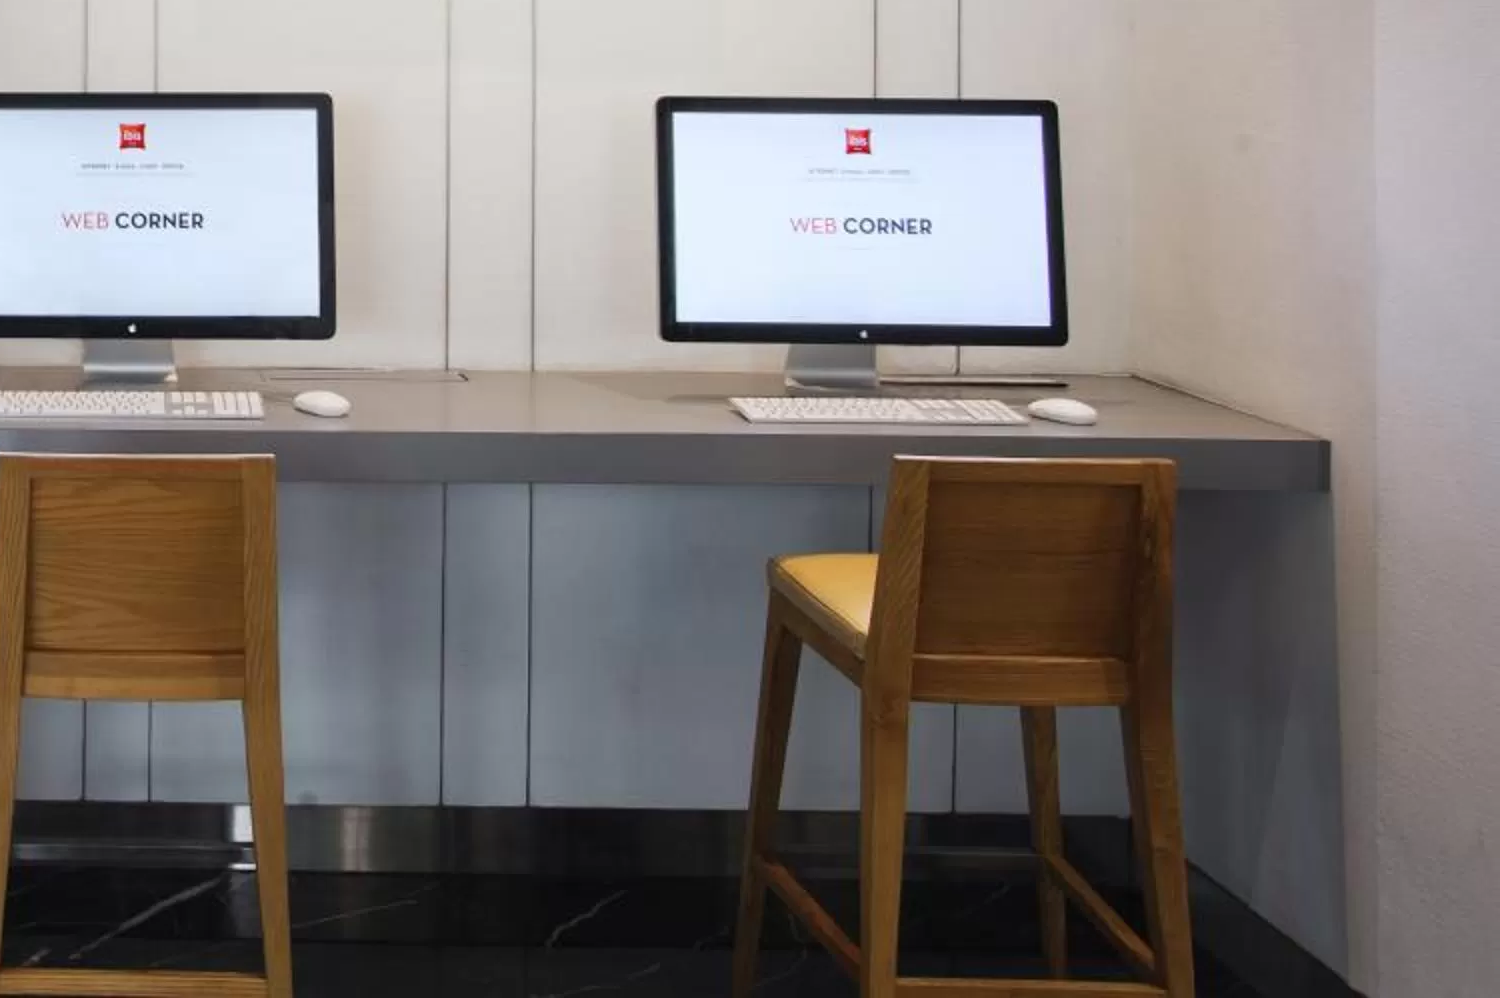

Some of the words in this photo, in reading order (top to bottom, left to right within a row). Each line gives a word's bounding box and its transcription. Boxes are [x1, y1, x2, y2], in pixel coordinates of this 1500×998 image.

[61, 212, 109, 229] WEB
[114, 212, 204, 229] CORNER
[790, 217, 837, 234] WEB
[843, 217, 933, 234] CORNER
